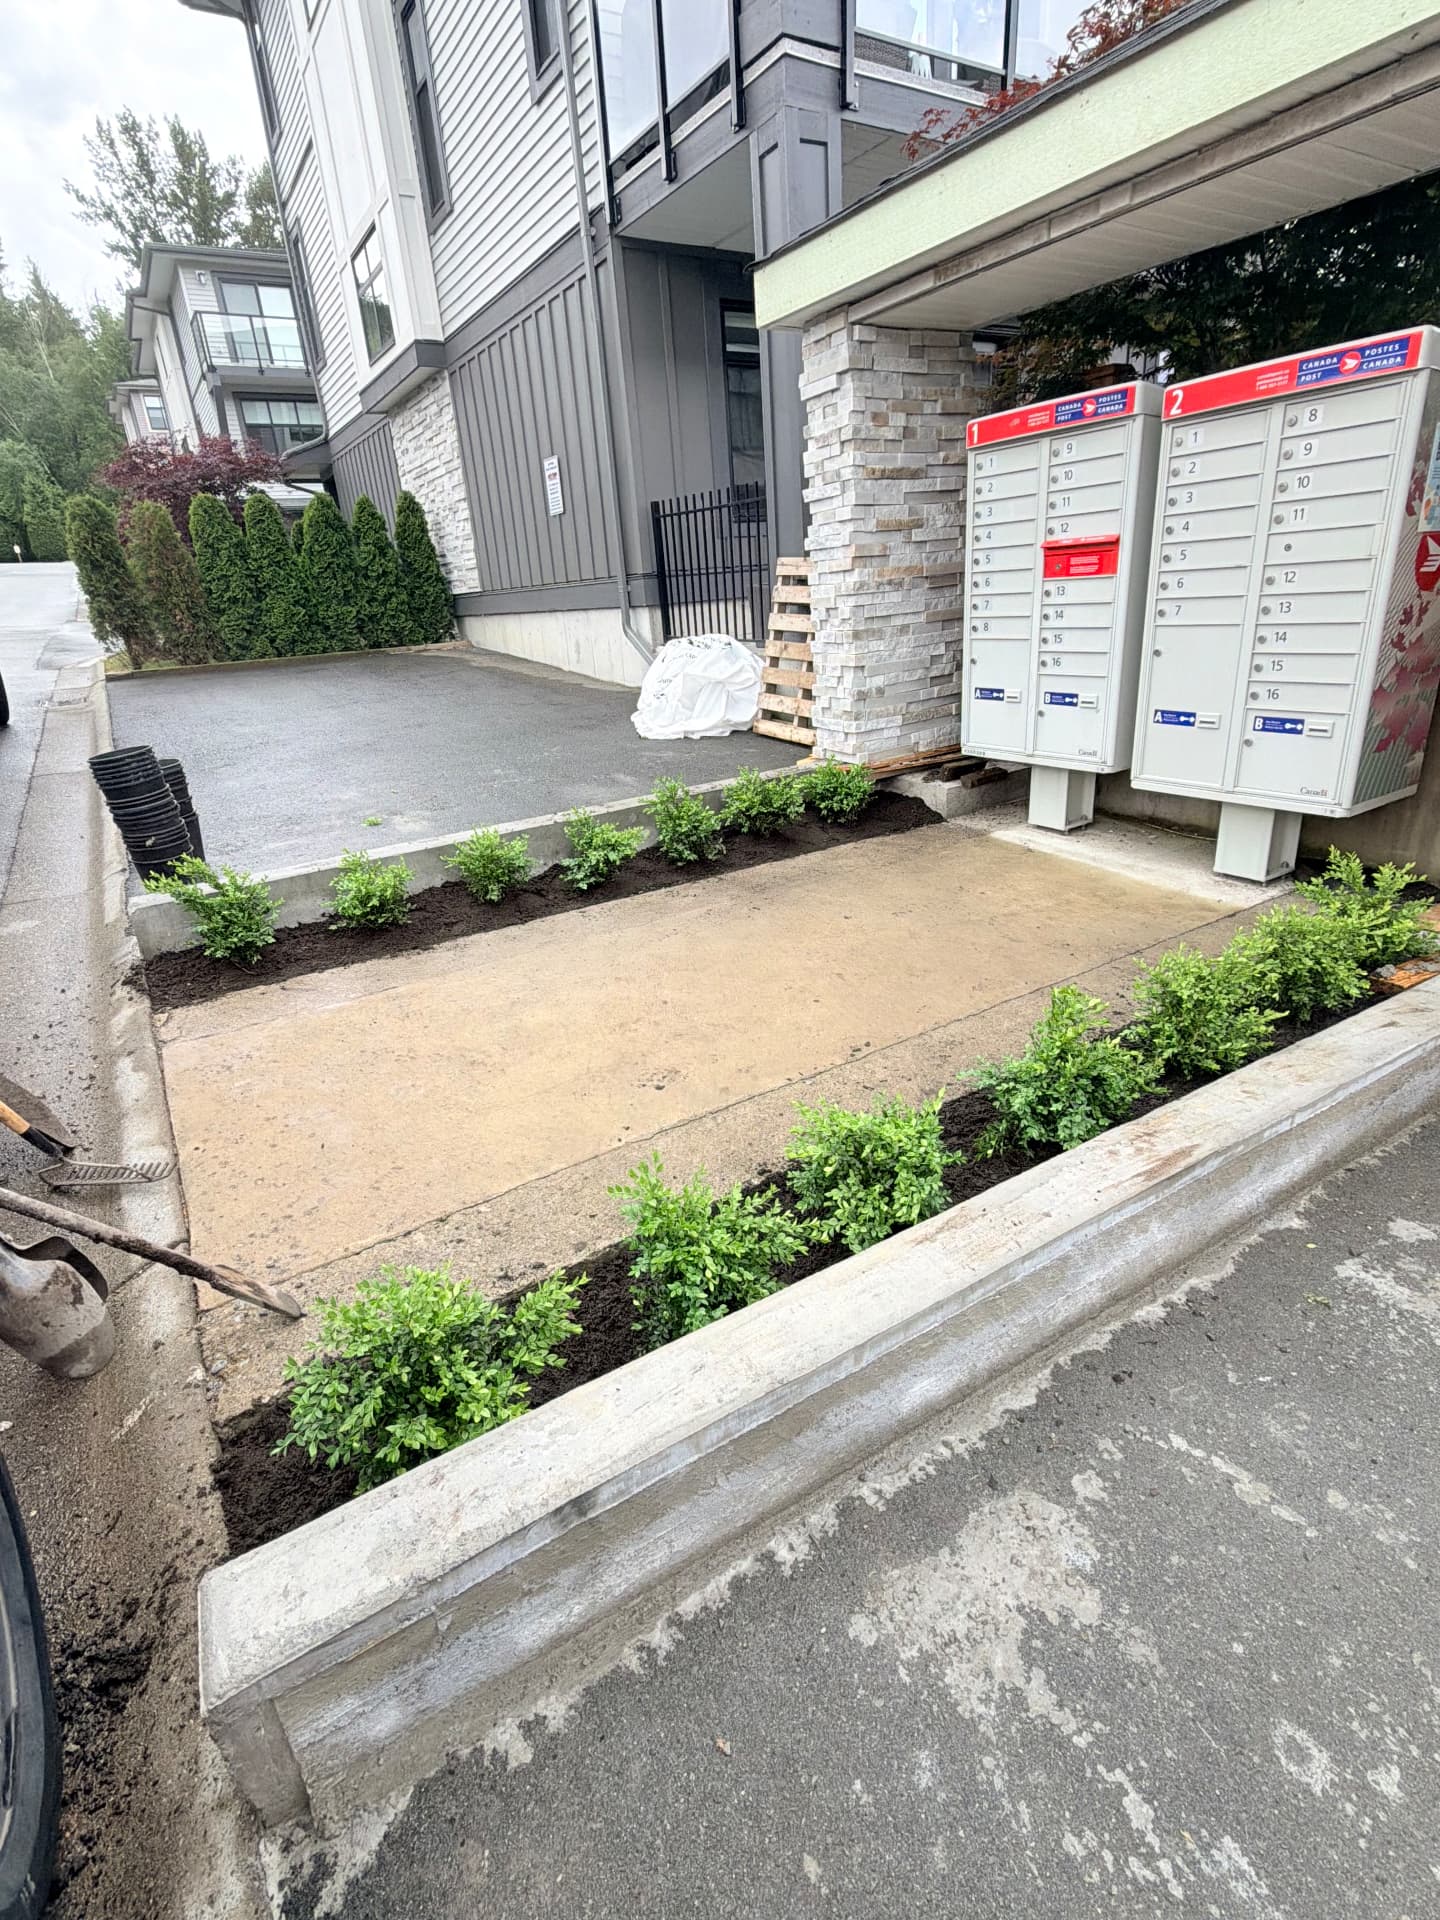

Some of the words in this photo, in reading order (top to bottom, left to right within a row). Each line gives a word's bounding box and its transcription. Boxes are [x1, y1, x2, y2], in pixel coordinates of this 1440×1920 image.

[1364, 343, 1400, 357] POSTES
[1302, 356, 1338, 370] CANADA
[1362, 356, 1402, 370] CANADA
[1300, 372, 1322, 383] POST
[1098, 394, 1122, 403] POSTES
[1170, 389, 1184, 416] 2
[1057, 402, 1082, 412] CANADA
[1097, 404, 1124, 414] CANADA
[1056, 414, 1072, 422] POST
[1307, 407, 1318, 423] 8
[971, 423, 979, 445] 1
[1065, 442, 1074, 454] 9
[1303, 442, 1313, 456] 9
[1188, 461, 1197, 474] 2
[1063, 469, 1073, 481] 10
[986, 482, 994, 493] 2
[1296, 475, 1311, 489] 10
[1061, 496, 1071, 507] 11
[1186, 491, 1193, 504] 3
[986, 506, 993, 517] 3
[1292, 507, 1305, 521] 11
[1060, 522, 1070, 533] 12
[1181, 520, 1190, 532] 4
[984, 530, 992, 541] 4
[984, 553, 991, 564] 5
[1179, 549, 1187, 561] 5
[984, 576, 991, 587] 6
[1176, 577, 1185, 589] 6
[1283, 570, 1297, 584] 12
[1056, 585, 1066, 596] 13
[983, 599, 990, 610] 7
[1174, 604, 1182, 616] 7
[1278, 601, 1292, 614] 13
[1054, 609, 1064, 620] 14
[982, 621, 989, 632] 8
[1053, 633, 1063, 644] 15
[1274, 630, 1288, 643] 14
[1051, 656, 1062, 667] 16
[1270, 659, 1284, 672] 15
[975, 689, 982, 698] A
[1045, 693, 1051, 703] B
[1266, 688, 1280, 700] 16
[1154, 711, 1163, 722] A
[1255, 718, 1264, 730] B
